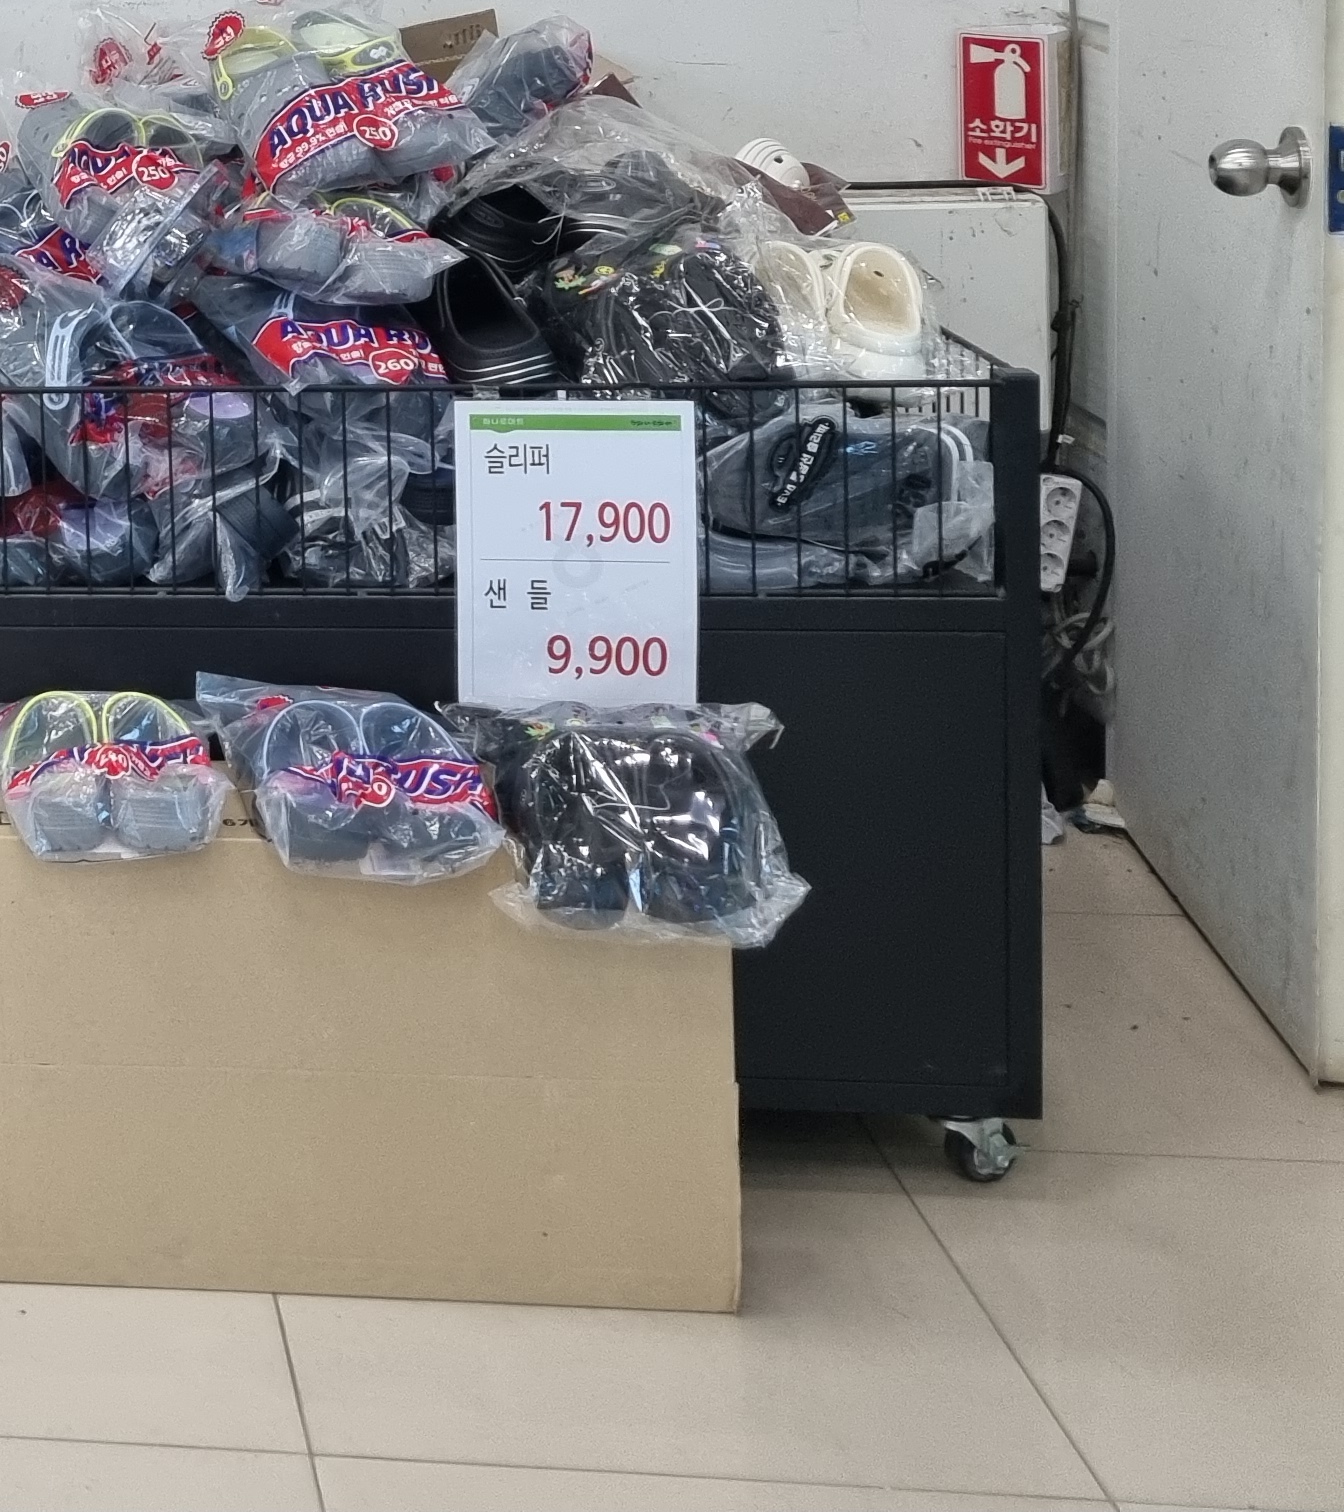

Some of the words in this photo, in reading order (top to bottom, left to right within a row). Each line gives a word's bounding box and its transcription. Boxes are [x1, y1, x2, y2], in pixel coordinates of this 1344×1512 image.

[269, 89, 359, 160] AQUA
[359, 125, 393, 141] 250
[967, 117, 1037, 143] 소화기
[968, 137, 982, 145] Fire
[984, 138, 1037, 150] extinguisher
[138, 166, 170, 182] 250
[377, 359, 413, 374] 260
[484, 442, 550, 475] 슬리퍼
[538, 501, 671, 548] 17,900
[484, 578, 507, 609] 샌
[526, 578, 552, 611] 들
[546, 634, 668, 680] 9,900
[396, 763, 484, 800] USH
